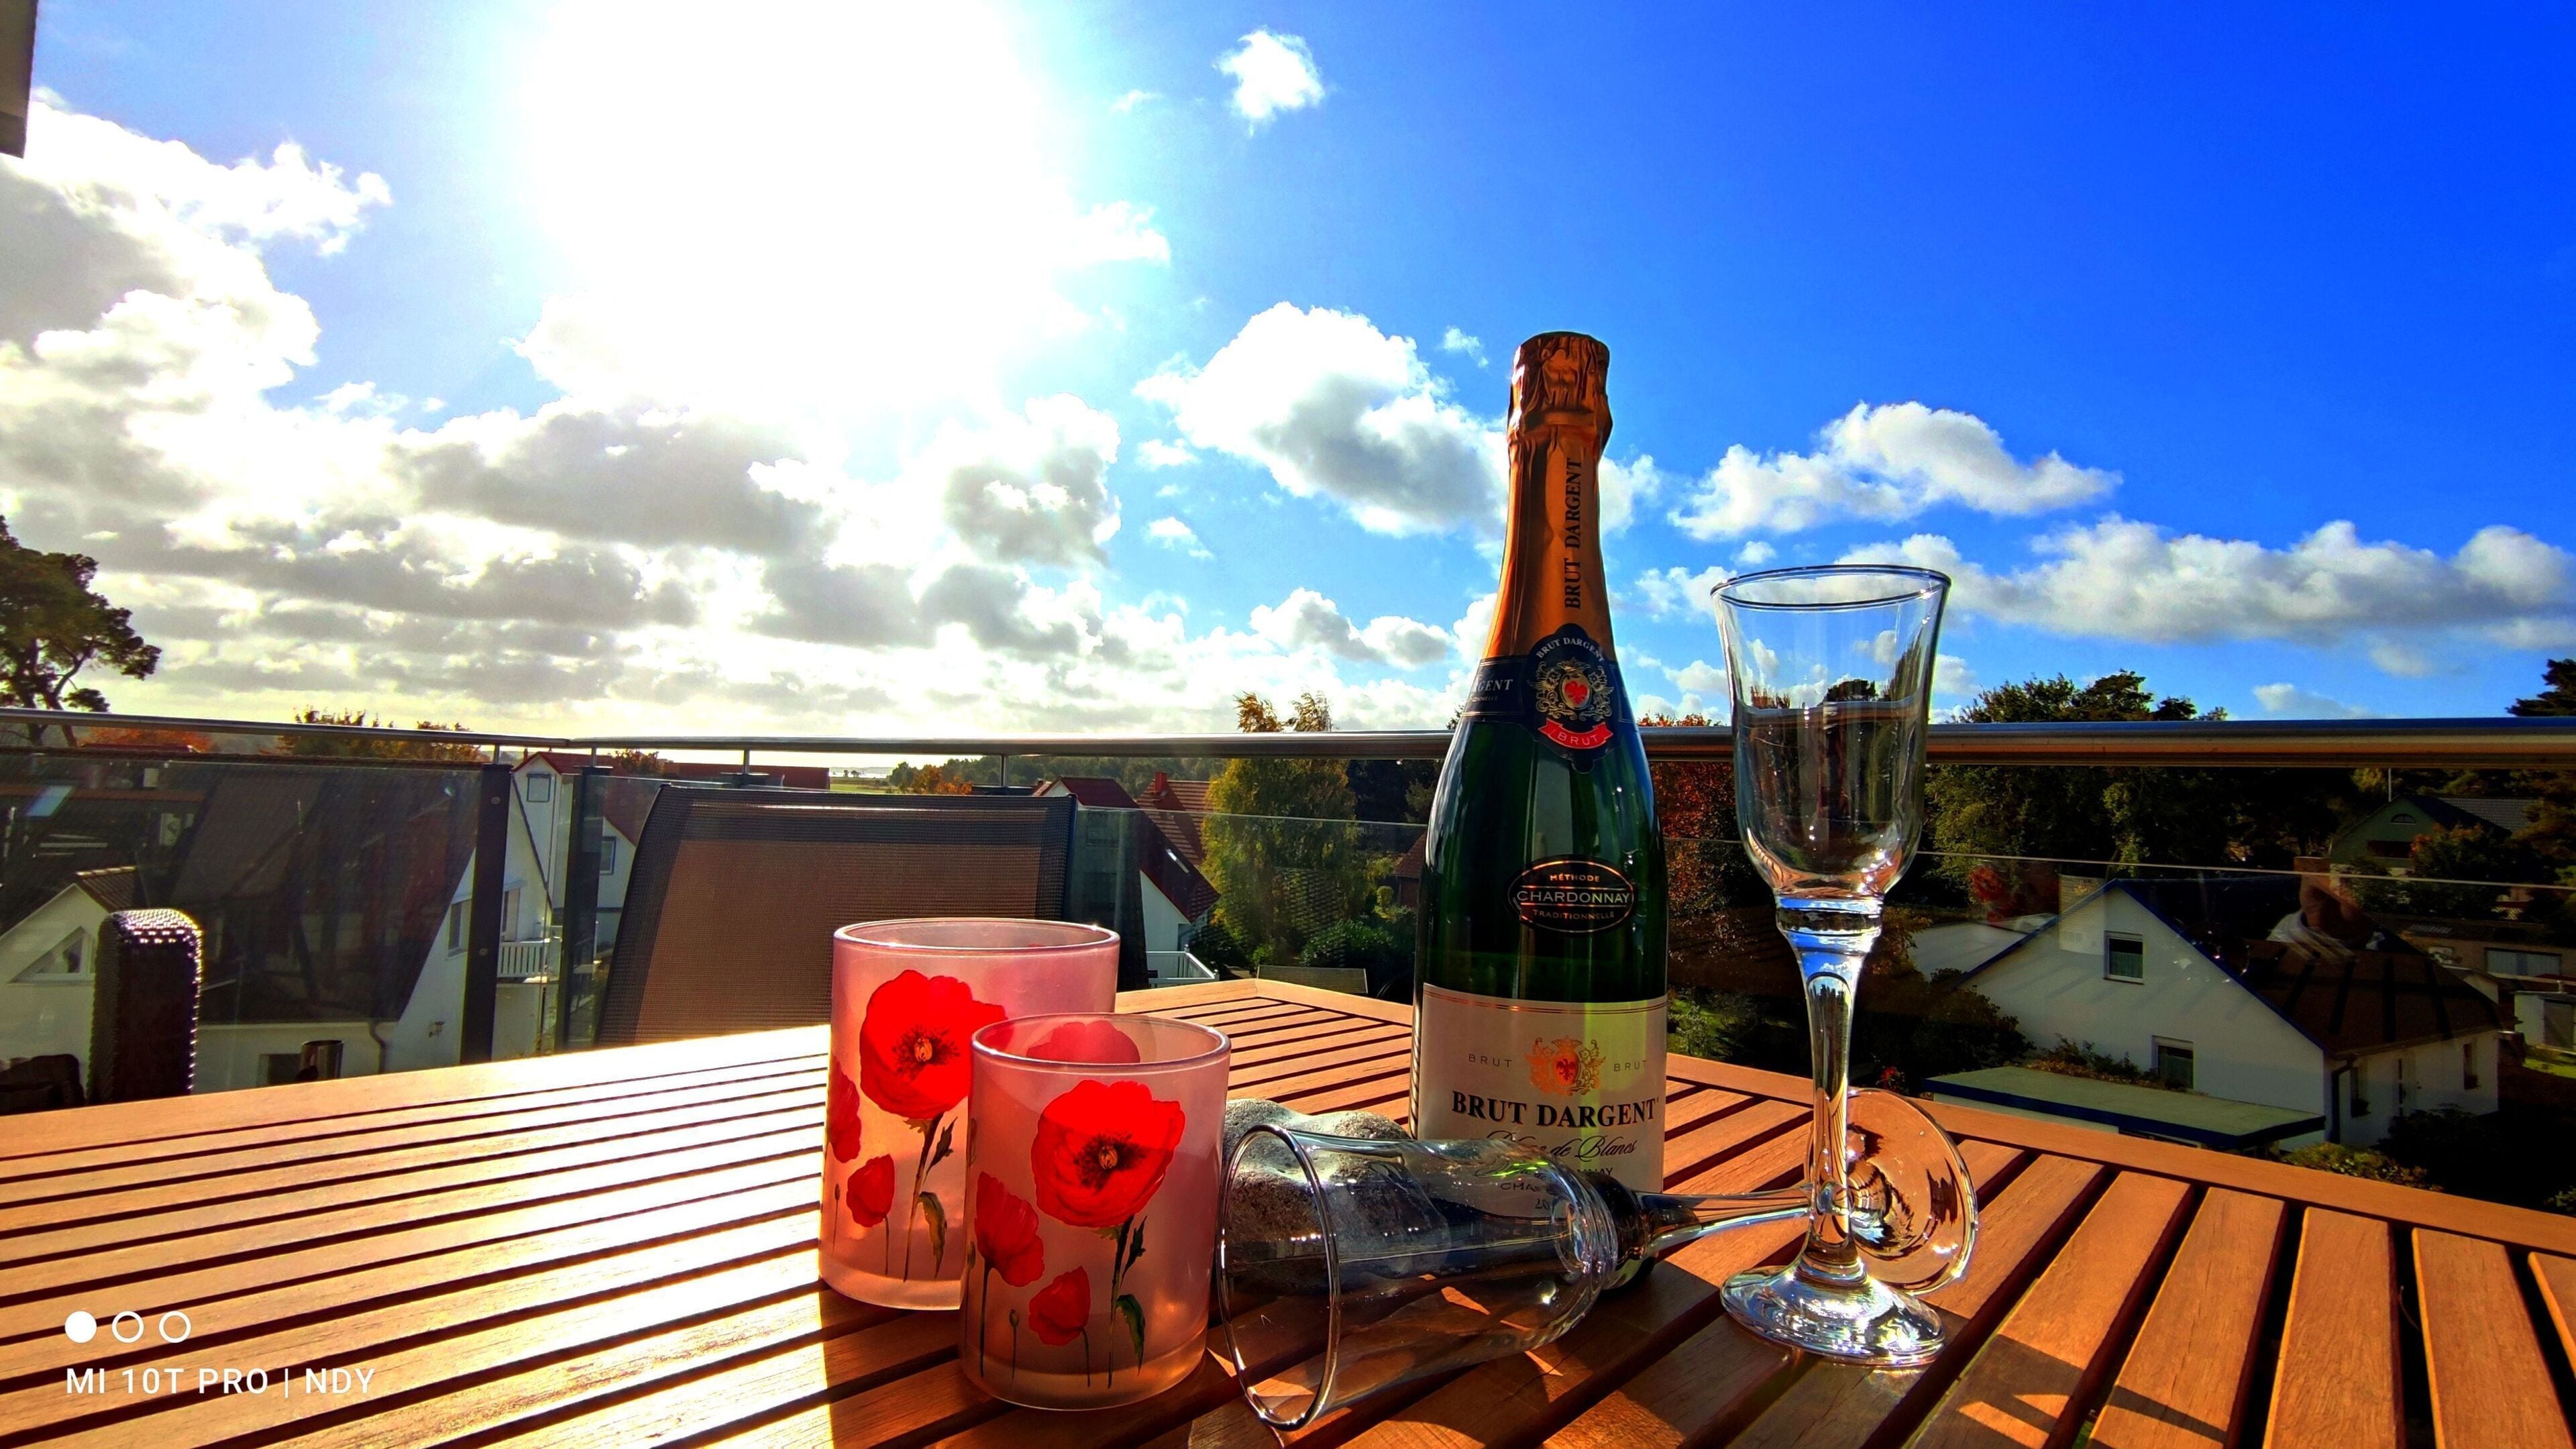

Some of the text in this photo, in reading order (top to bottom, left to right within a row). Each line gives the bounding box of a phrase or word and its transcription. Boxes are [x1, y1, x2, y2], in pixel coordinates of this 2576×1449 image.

[1564, 458, 1582, 610] BRUT DARGENT
[1536, 637, 1605, 662] BRUT DARGENT
[1558, 733, 1599, 746] BRUT
[1550, 873, 1600, 883] MÉTHODE
[1516, 890, 1630, 904] CHARDONNAY
[1532, 908, 1615, 920] TRADITIONNELLE
[1468, 1053, 1513, 1069] BRUT
[1613, 1060, 1648, 1072] BRUT
[1452, 1091, 1527, 1126] BRUT
[1550, 1138, 1572, 1157] de
[1574, 1134, 1638, 1162] Blancs
